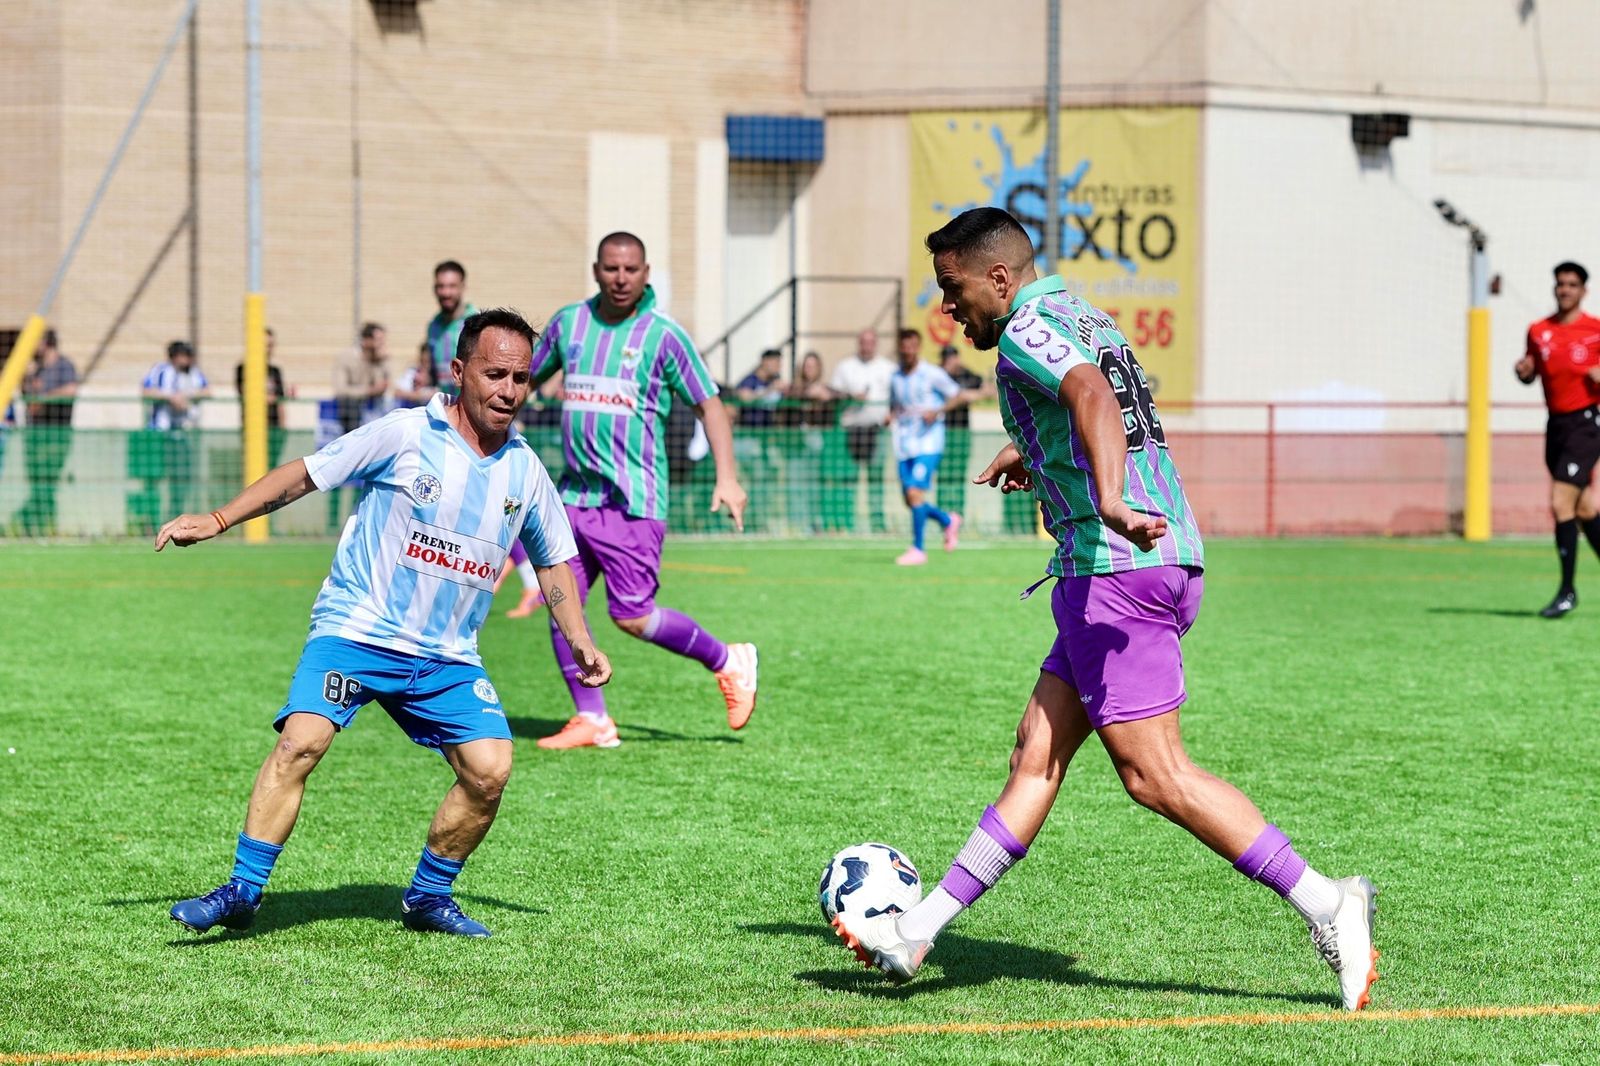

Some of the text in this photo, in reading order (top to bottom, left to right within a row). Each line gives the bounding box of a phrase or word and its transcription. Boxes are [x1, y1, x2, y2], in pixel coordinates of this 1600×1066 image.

[1006, 183, 1177, 261] Sixto
[1134, 308, 1175, 348] 56
[411, 530, 461, 554] FRENTE
